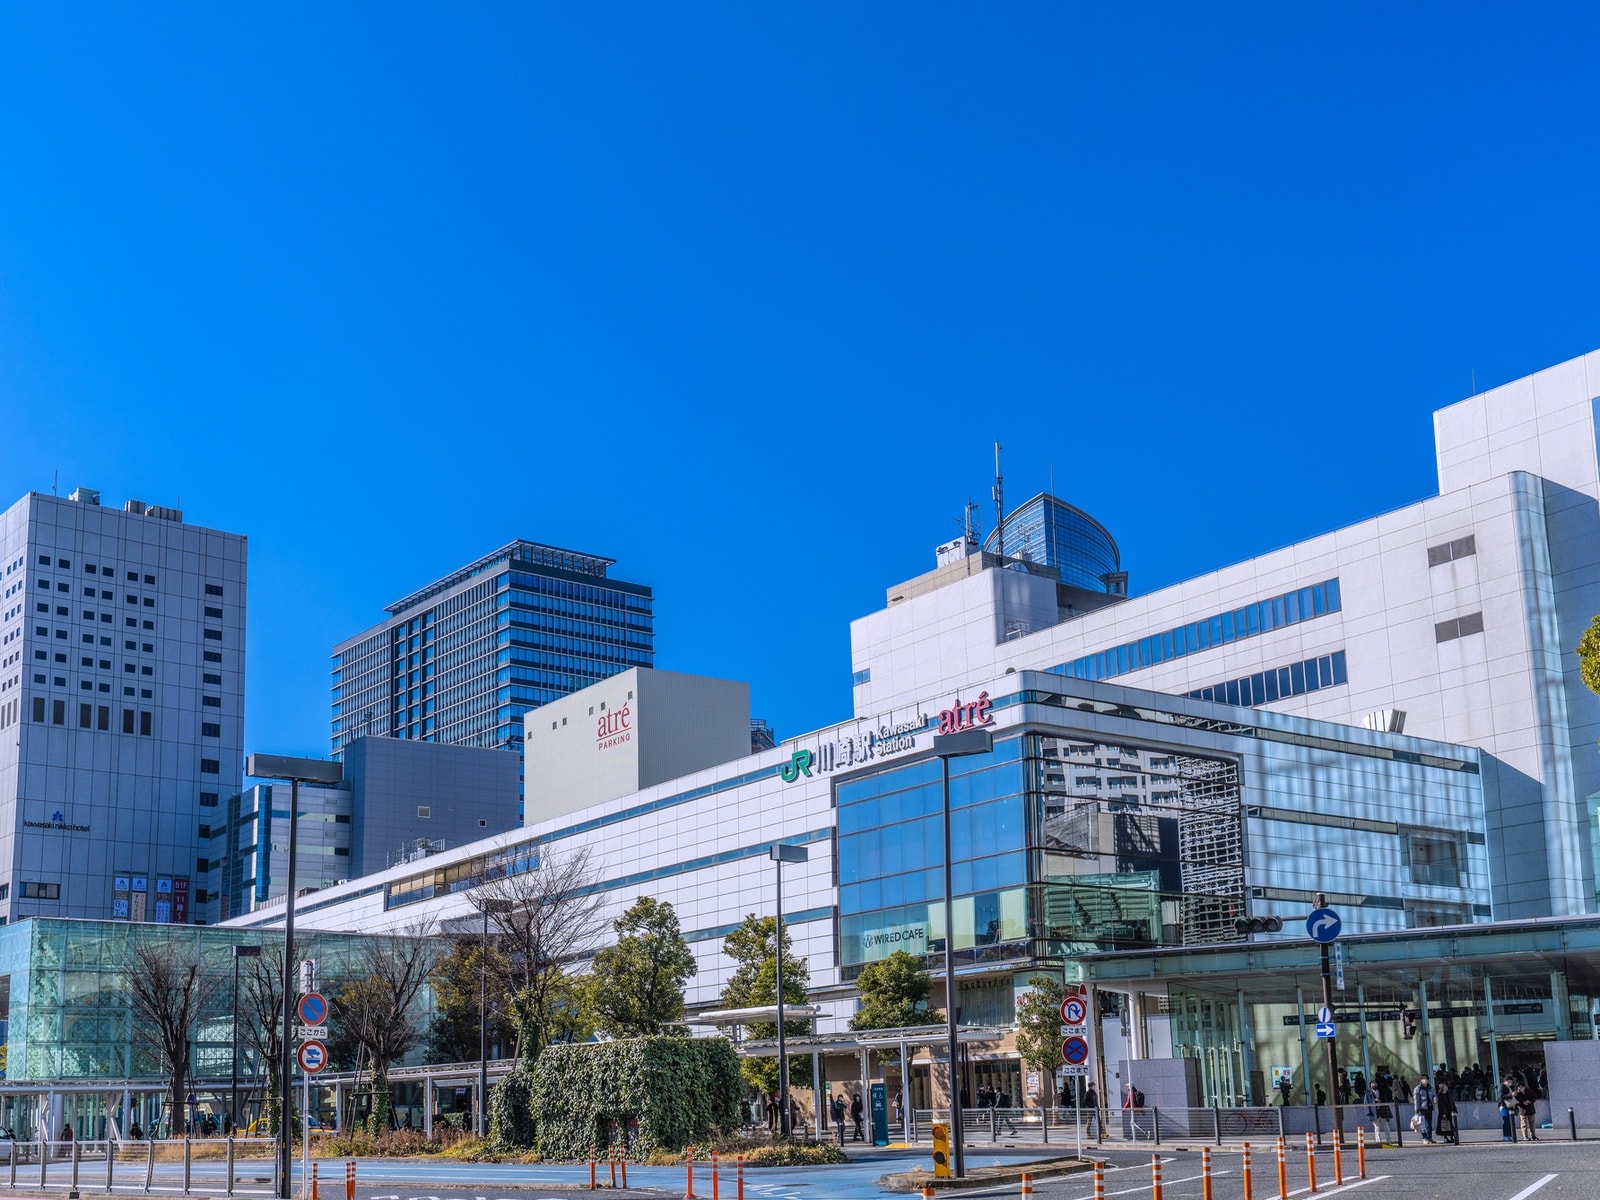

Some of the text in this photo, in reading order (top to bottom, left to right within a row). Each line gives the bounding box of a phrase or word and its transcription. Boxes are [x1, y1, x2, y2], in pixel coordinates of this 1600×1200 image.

[597, 702, 631, 737] atré
[938, 691, 992, 735] atré
[876, 713, 927, 740] Kawasaki
[598, 733, 631, 750] PARKING
[876, 736, 914, 756] Station
[781, 731, 875, 782] JR 川崎駅
[24, 820, 90, 832] kawasaki nikko hotel
[175, 881, 187, 889] B1F
[874, 928, 924, 945] WIRED CAFE
[299, 1028, 326, 1036] ここから
